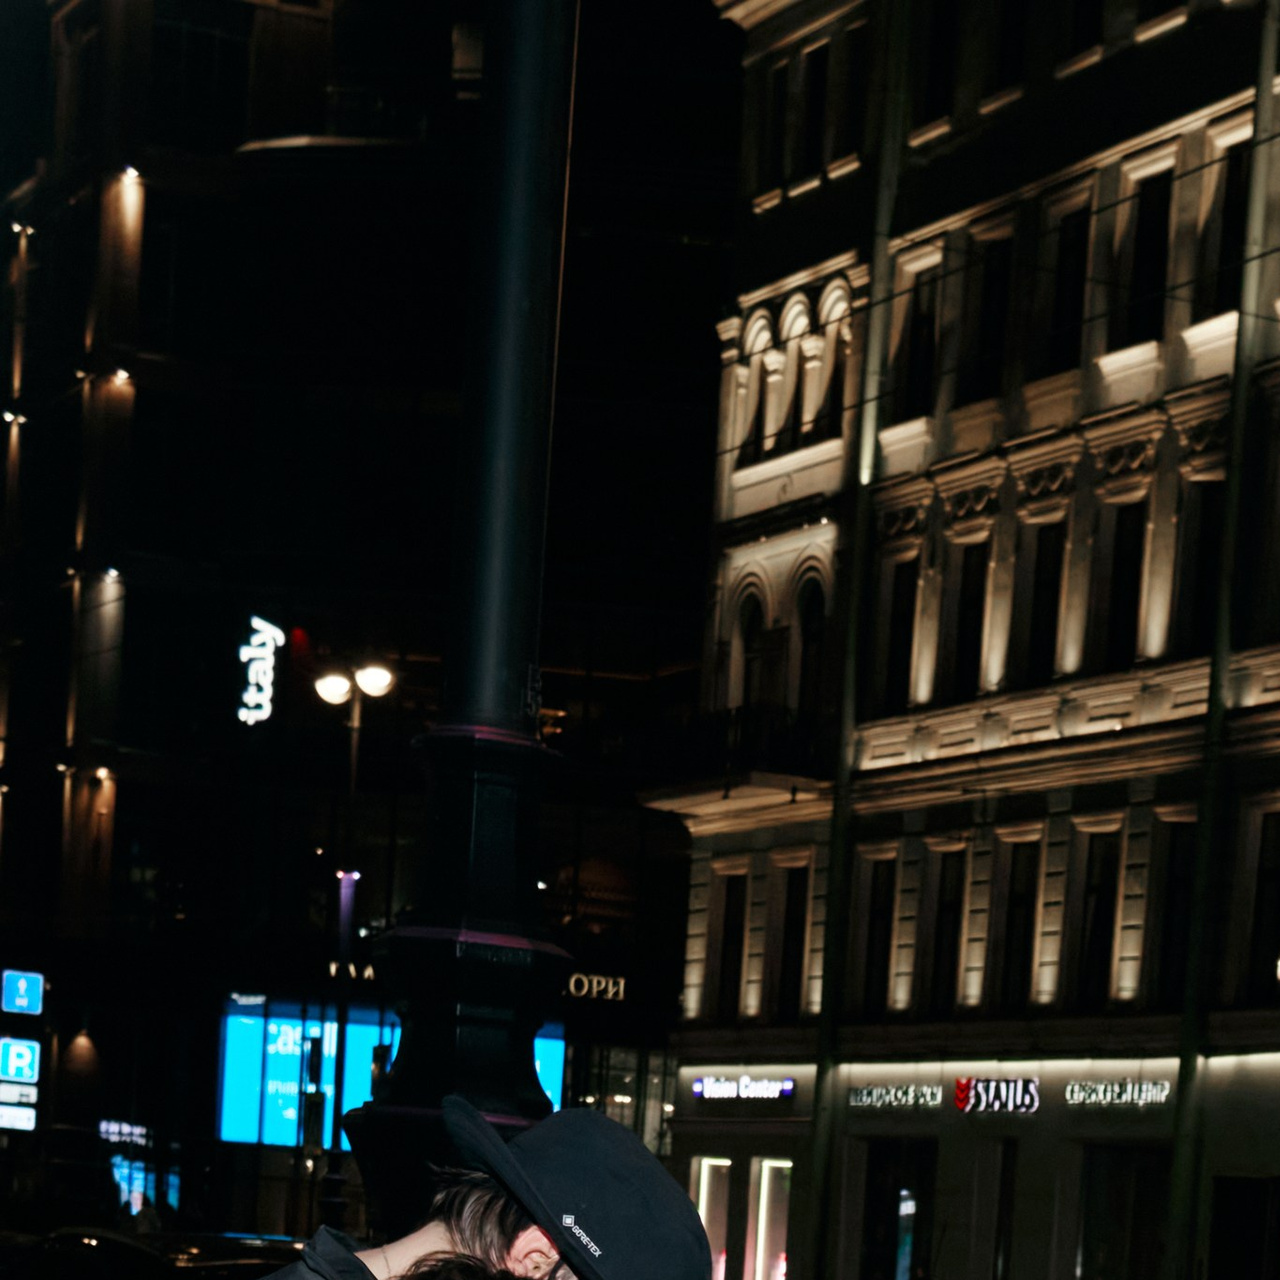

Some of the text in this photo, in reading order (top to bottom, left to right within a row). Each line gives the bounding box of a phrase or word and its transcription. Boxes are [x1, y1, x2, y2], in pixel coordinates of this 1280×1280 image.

[238, 615, 286, 726] italy
[703, 1075, 783, 1098] Vision Center
